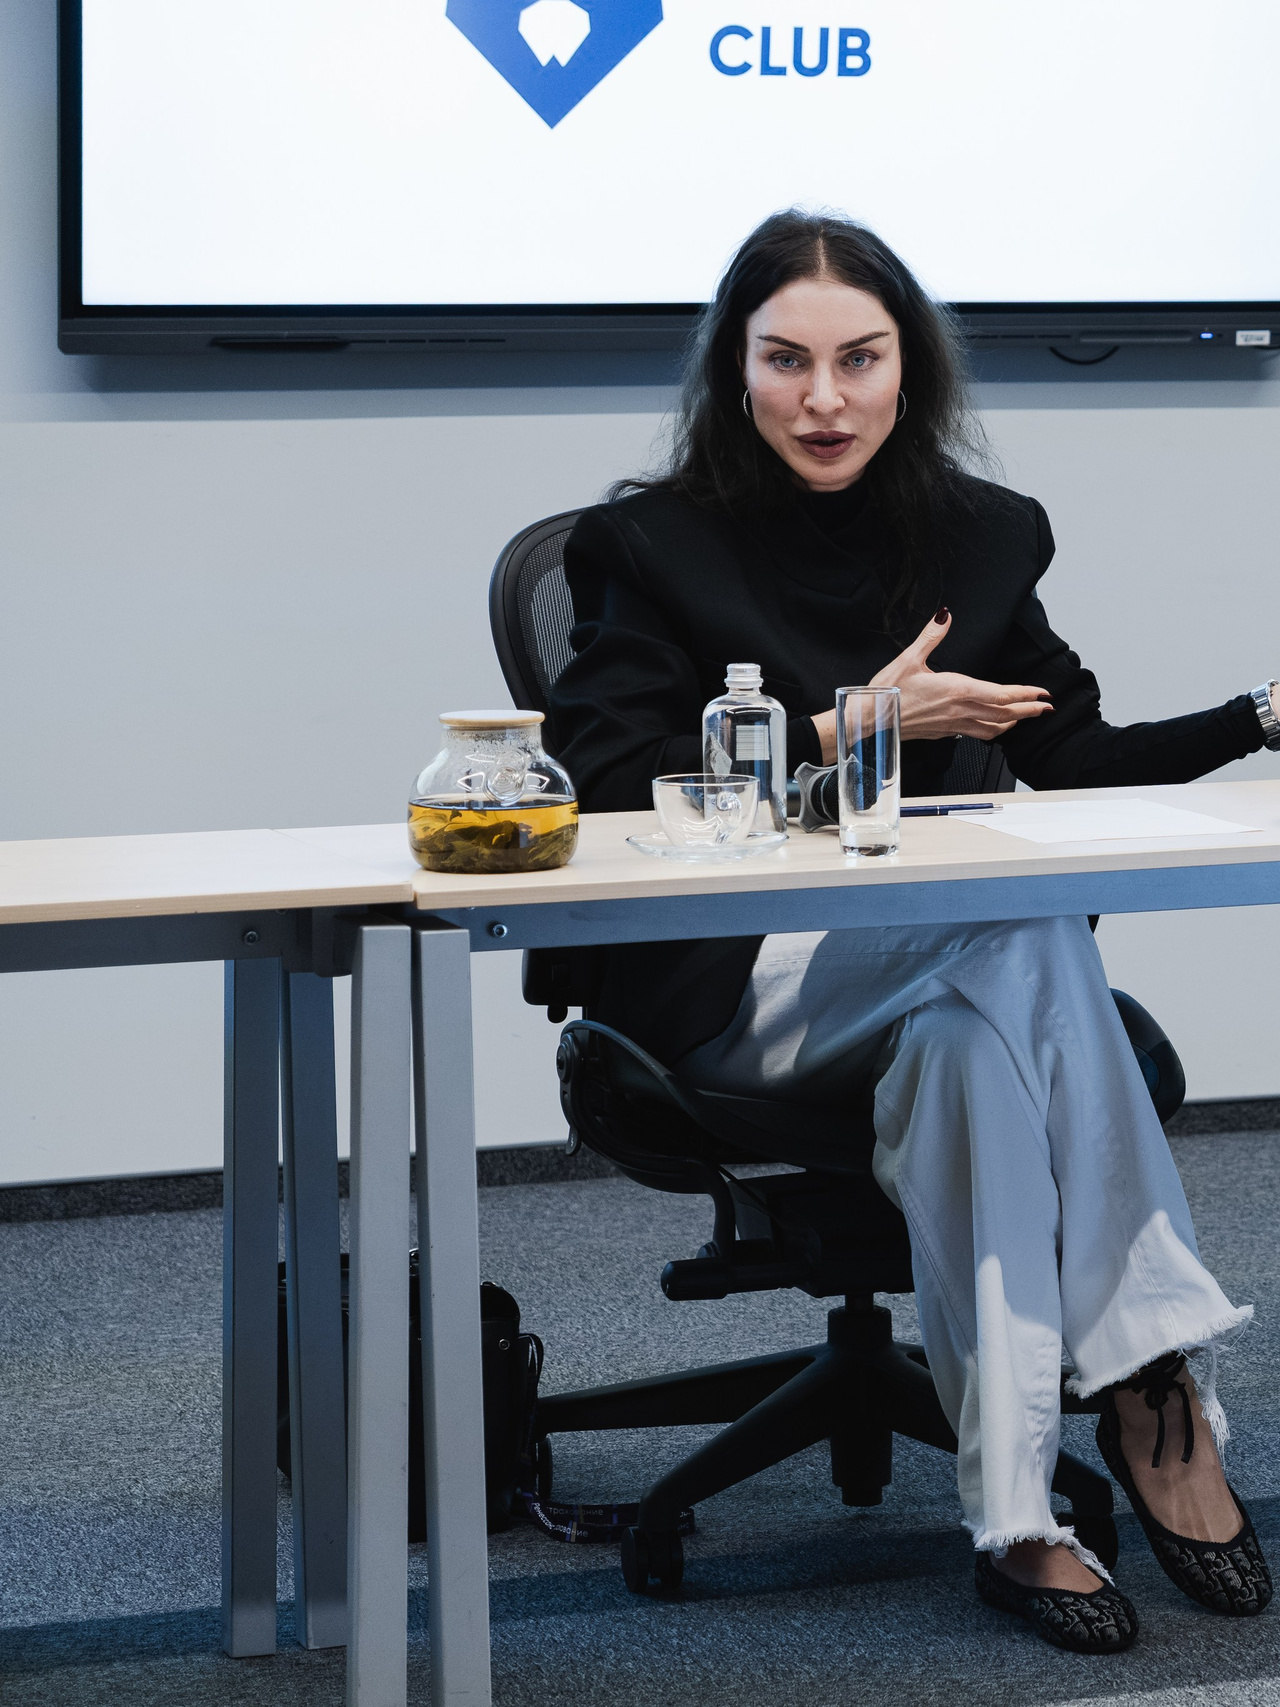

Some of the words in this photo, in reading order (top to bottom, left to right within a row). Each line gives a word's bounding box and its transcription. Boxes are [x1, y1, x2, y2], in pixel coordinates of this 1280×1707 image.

[709, 24, 872, 78] CLUB
[531, 1502, 555, 1530] Ренесса
[554, 1524, 589, 1538] ование
[546, 1506, 604, 1516] трахование
